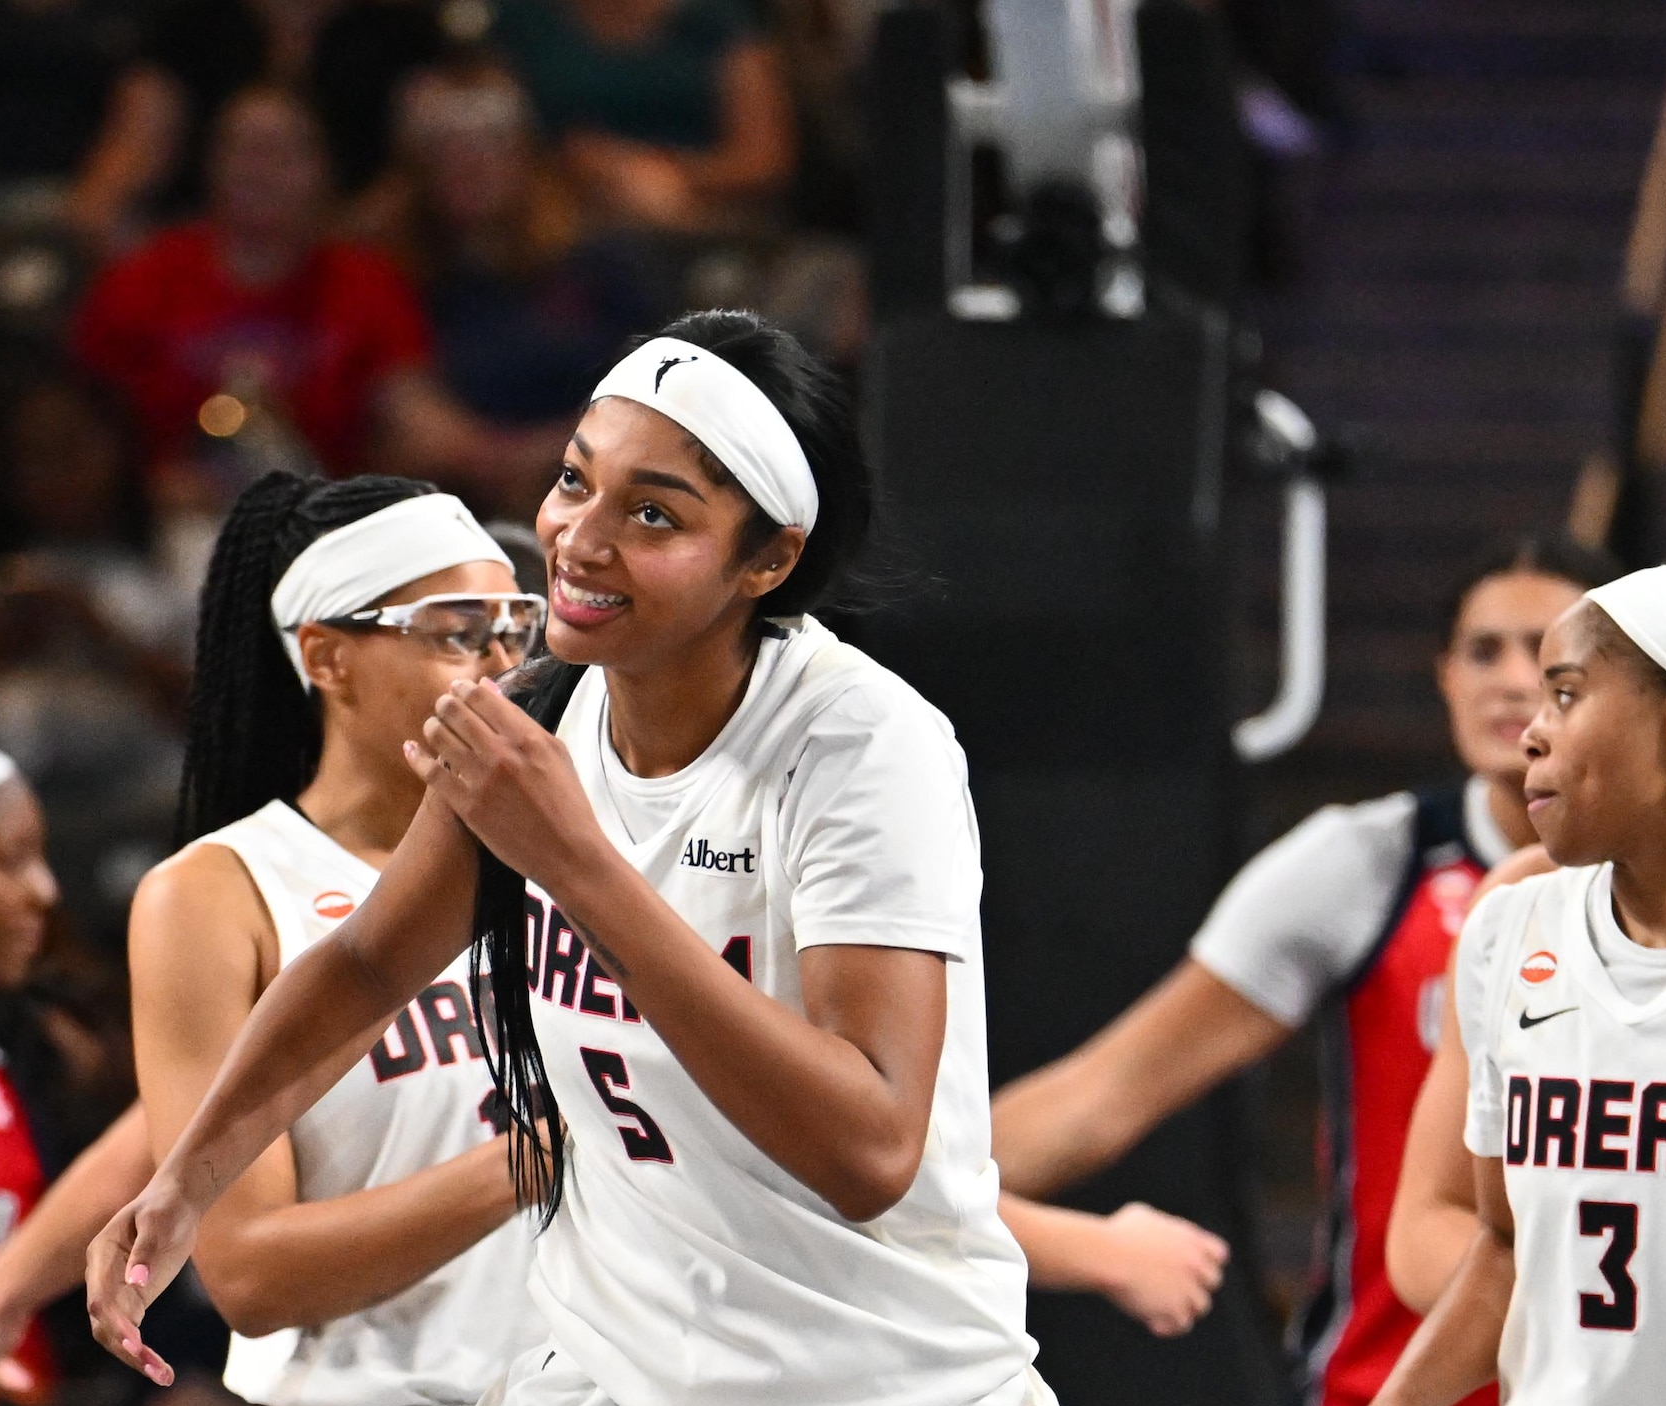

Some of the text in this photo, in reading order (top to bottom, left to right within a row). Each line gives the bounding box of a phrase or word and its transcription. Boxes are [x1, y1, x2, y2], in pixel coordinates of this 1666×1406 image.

[680, 838, 755, 873] Albert
[579, 1046, 674, 1165] 5
[1578, 1199, 1639, 1331] 3
